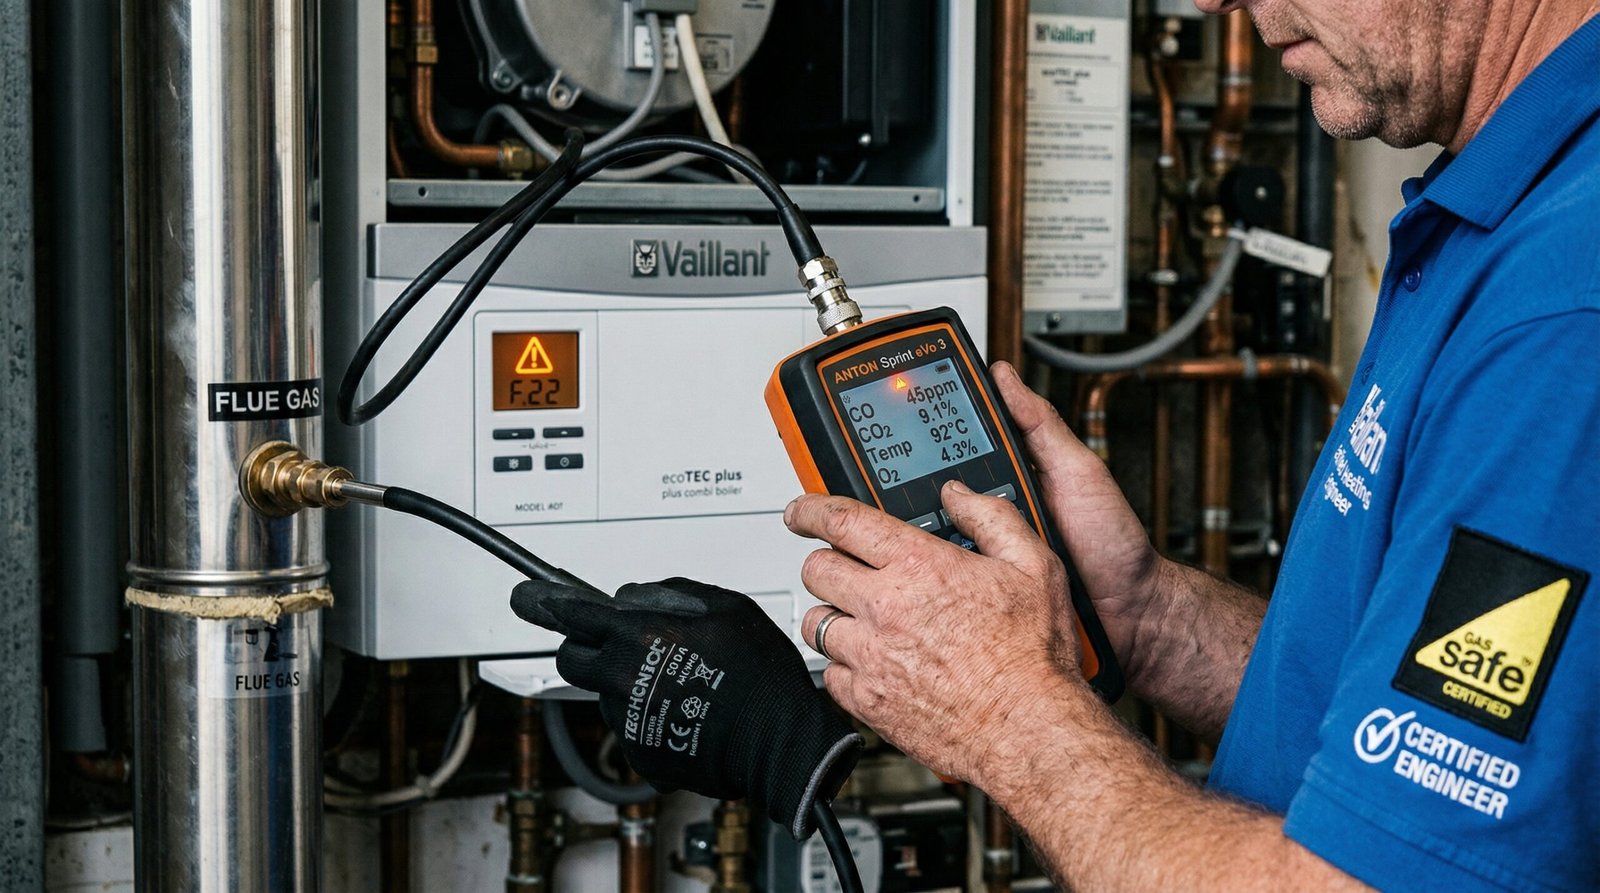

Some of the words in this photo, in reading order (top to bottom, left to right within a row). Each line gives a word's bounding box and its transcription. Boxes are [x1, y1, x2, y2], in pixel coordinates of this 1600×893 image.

[661, 240, 771, 277] Vaillant
[834, 360, 879, 384] ANTON
[880, 350, 915, 370] Sprint
[915, 343, 937, 358] eVo
[937, 338, 947, 350] 3
[215, 390, 280, 413] FLUE
[286, 386, 320, 410] GAS
[510, 379, 561, 405] F.22
[849, 403, 875, 423] CO
[906, 378, 959, 405] 45ppm
[918, 400, 959, 424] 9.1%
[866, 440, 913, 464] Temp
[930, 418, 969, 443] 92°C
[940, 439, 978, 464] 4.3%
[662, 470, 710, 484] ecoTEC
[715, 468, 742, 484] plus
[662, 487, 682, 500] plus
[684, 486, 713, 497] combi
[715, 485, 742, 496] boiler
[515, 503, 545, 512] MODEL
[1464, 632, 1493, 651] GAS
[1440, 640, 1525, 693] safe
[235, 673, 271, 691] FLUE
[275, 671, 300, 689] GAS
[1442, 680, 1512, 719] CERTIFIED
[1404, 722, 1520, 789] CERTIFIED
[1393, 749, 1509, 820] ENGINEER
